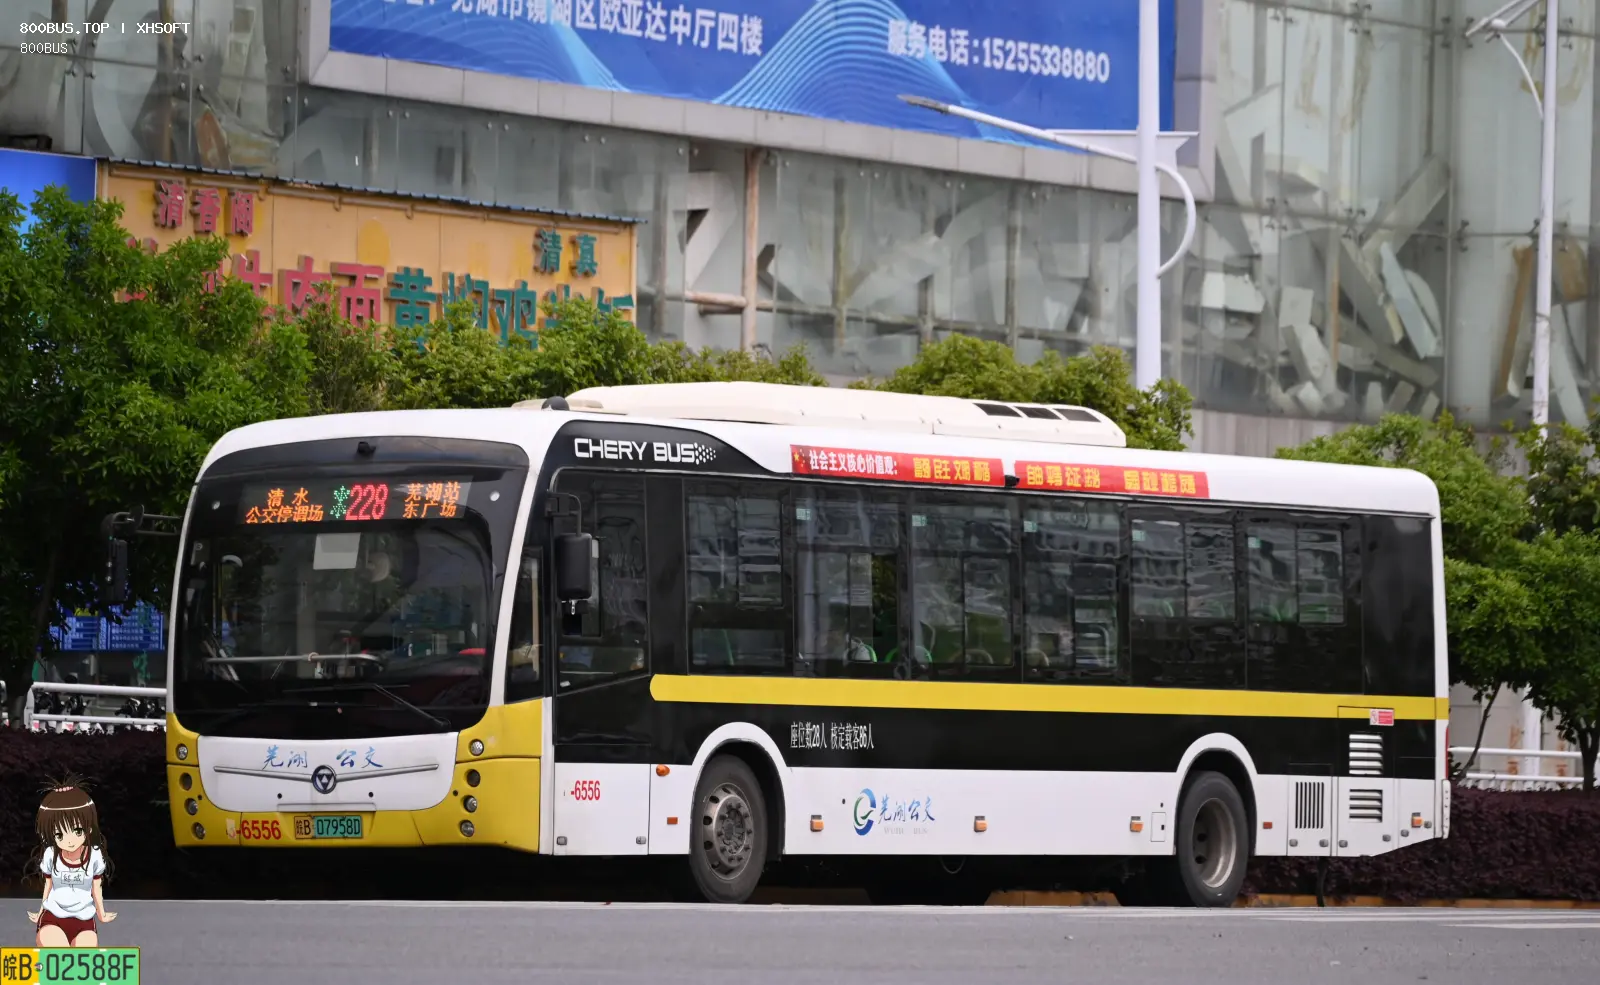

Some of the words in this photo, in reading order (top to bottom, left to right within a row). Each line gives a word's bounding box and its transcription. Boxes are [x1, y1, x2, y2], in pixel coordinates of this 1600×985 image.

[537, 229, 599, 277] 清真
[574, 437, 648, 461] CHERY
[652, 441, 696, 463] BUS
[345, 484, 389, 521] 228
[405, 481, 462, 502] 芜湖站
[402, 500, 458, 519] 东广场
[335, 746, 384, 769] 公交
[571, 780, 601, 801] -6556
[227, 819, 282, 841] -6556
